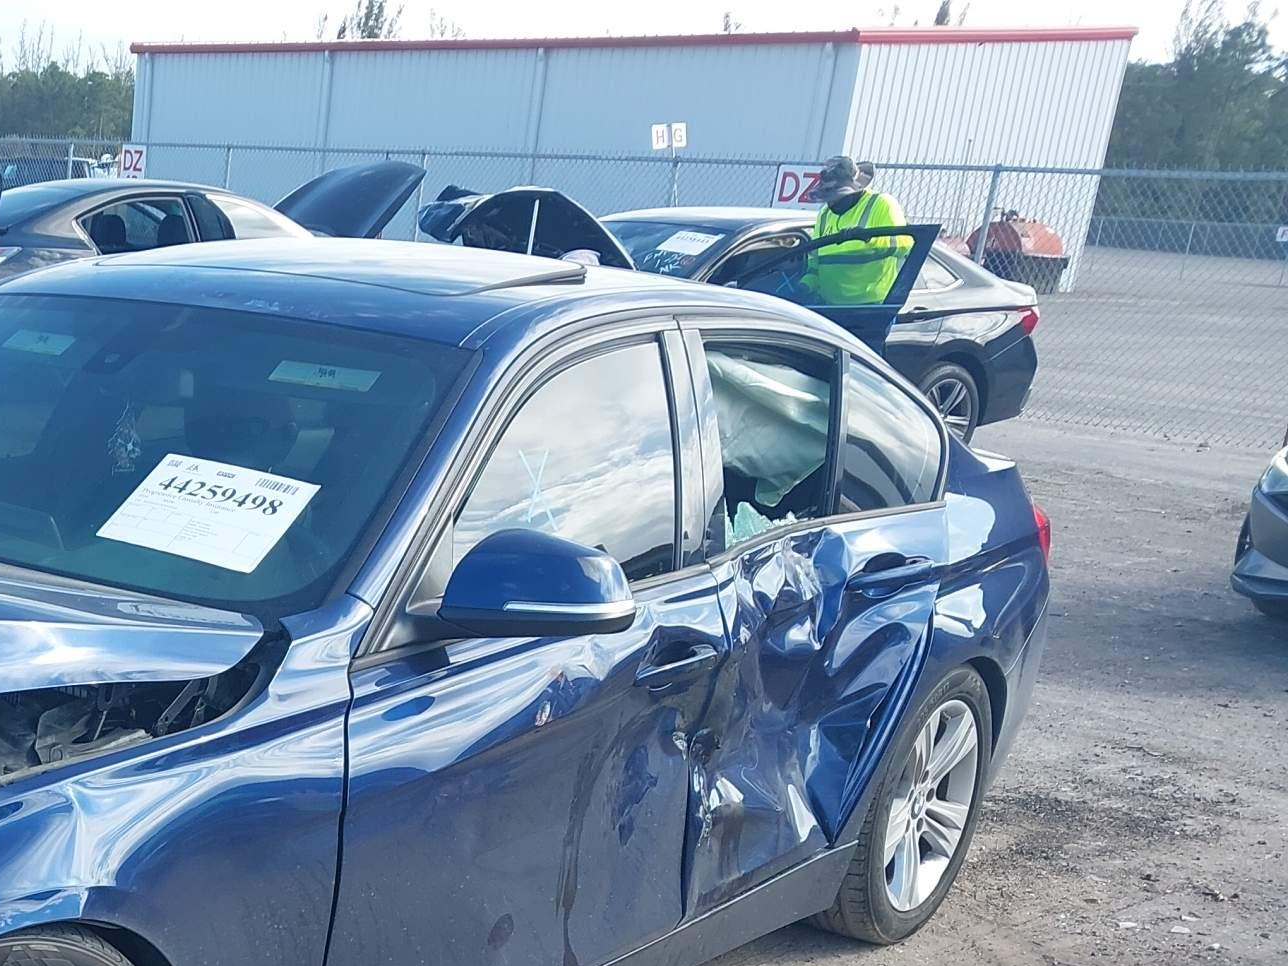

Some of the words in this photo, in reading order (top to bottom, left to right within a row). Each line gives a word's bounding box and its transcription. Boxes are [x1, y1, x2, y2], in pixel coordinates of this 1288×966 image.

[655, 128, 665, 145] H
[673, 127, 683, 143] G
[123, 149, 144, 172] DZ
[777, 170, 821, 203] DZ
[159, 475, 284, 516] 44259498
